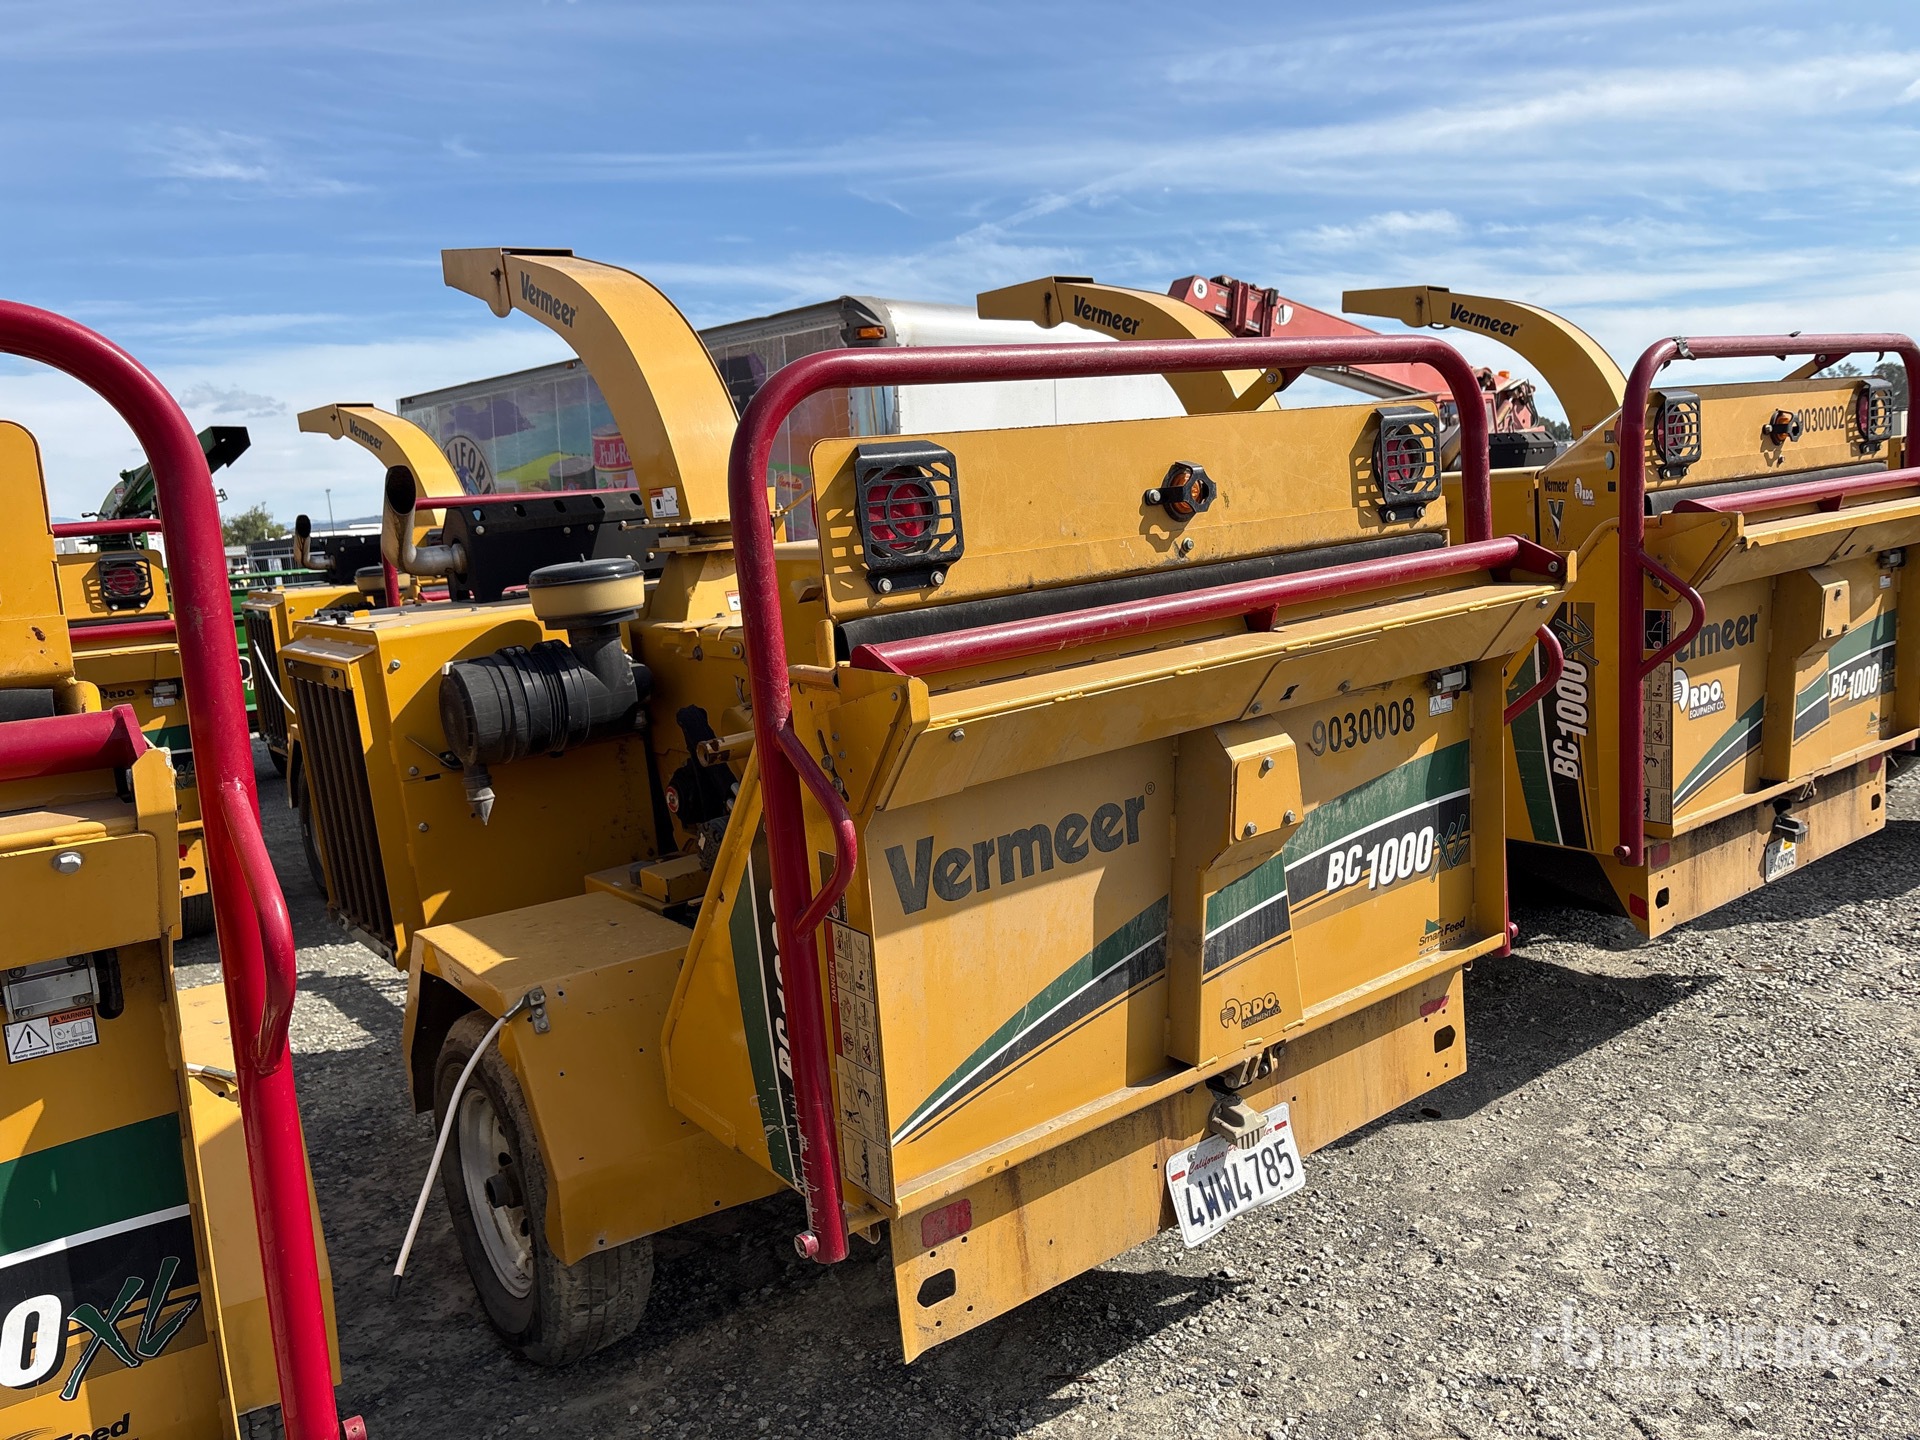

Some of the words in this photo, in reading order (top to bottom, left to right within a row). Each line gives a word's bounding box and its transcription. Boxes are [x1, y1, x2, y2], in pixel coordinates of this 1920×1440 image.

[520, 271, 576, 329] Vermeer
[1074, 294, 1140, 336] Vermeer
[1450, 302, 1520, 337] Vermeer
[349, 418, 383, 451] Vermeer
[1543, 476, 1568, 493] Vermeer
[1674, 613, 1758, 663] ermeer
[1555, 660, 1588, 737] 1000
[1690, 679, 1723, 708] RDO
[1830, 670, 1848, 701] BC
[1848, 663, 1880, 702] 1000
[1312, 698, 1415, 757] 9030008
[1689, 703, 1716, 719] EQUIPMENT
[1553, 739, 1579, 780] BC
[884, 795, 1145, 916] Vermeer
[1326, 844, 1363, 892] BC
[1366, 826, 1434, 890] 1000
[828, 961, 838, 1003] DANGER
[60, 1009, 91, 1021] WARNING
[1241, 992, 1277, 1020] RDO
[1242, 1010, 1271, 1028] EQUIPMENT
[1185, 1138, 1295, 1227] 4WW4785
[1188, 1151, 1225, 1175] California
